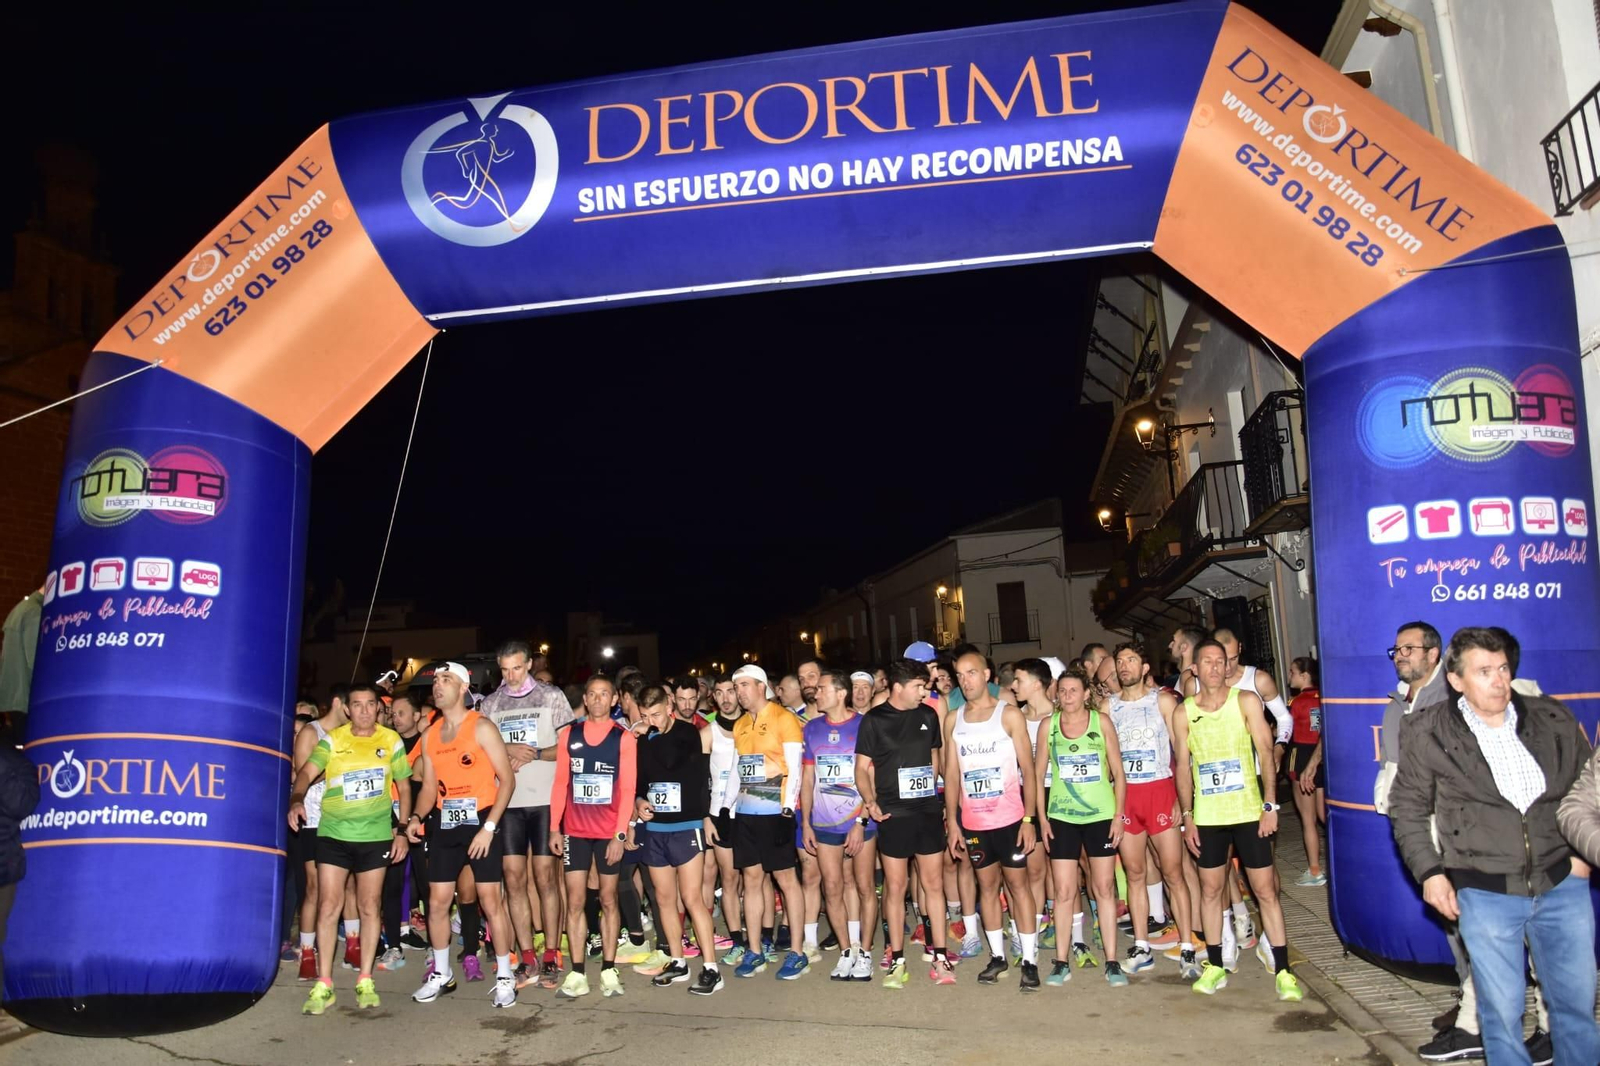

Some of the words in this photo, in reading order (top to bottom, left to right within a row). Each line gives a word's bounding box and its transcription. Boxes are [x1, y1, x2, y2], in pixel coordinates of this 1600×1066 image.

[584, 50, 1098, 165] DEPORTIME
[1225, 46, 1474, 241] DEPORTIME
[578, 184, 626, 213] SIN
[634, 167, 780, 207] ESFUERZO
[787, 162, 834, 191] NO
[842, 156, 904, 186] HAY
[911, 136, 1124, 180] RECOMPENSA
[1221, 89, 1423, 255] www.deportime.com
[1235, 142, 1286, 186] 623
[1282, 180, 1314, 214] 01
[1313, 205, 1351, 240] 98
[1345, 231, 1385, 267] 28
[123, 156, 322, 342] DEPORTIME
[152, 189, 327, 345] www.deportime.com
[203, 295, 248, 336] 623
[244, 272, 277, 300] 01
[271, 244, 305, 275] 98
[299, 218, 333, 249] 28
[1533, 427, 1573, 440] Publicidad
[160, 497, 214, 512] Publicidad
[1378, 557, 1408, 588] Tu
[1415, 557, 1480, 586] empresa
[1490, 543, 1510, 569] de
[1519, 541, 1586, 571] Publicidad
[198, 573, 217, 581] LOGO
[1454, 584, 1487, 600] 661
[1493, 582, 1530, 599] 848
[1535, 582, 1561, 598] 071
[98, 598, 116, 620] de
[123, 596, 213, 622] Publicidad
[68, 633, 92, 650] 661
[95, 631, 130, 647] 848
[133, 632, 165, 648] 071
[509, 730, 527, 743] 142
[966, 741, 997, 756] Salud
[742, 764, 755, 776] 321
[827, 765, 840, 776] 70
[1072, 765, 1088, 776] 26
[1129, 760, 1143, 772] 78
[37, 750, 226, 799] PORTIME
[1212, 772, 1227, 786] 67
[355, 779, 375, 792] 231
[583, 785, 600, 797] 109
[909, 777, 928, 790] 260
[655, 793, 667, 804] 82
[448, 810, 468, 821] 383
